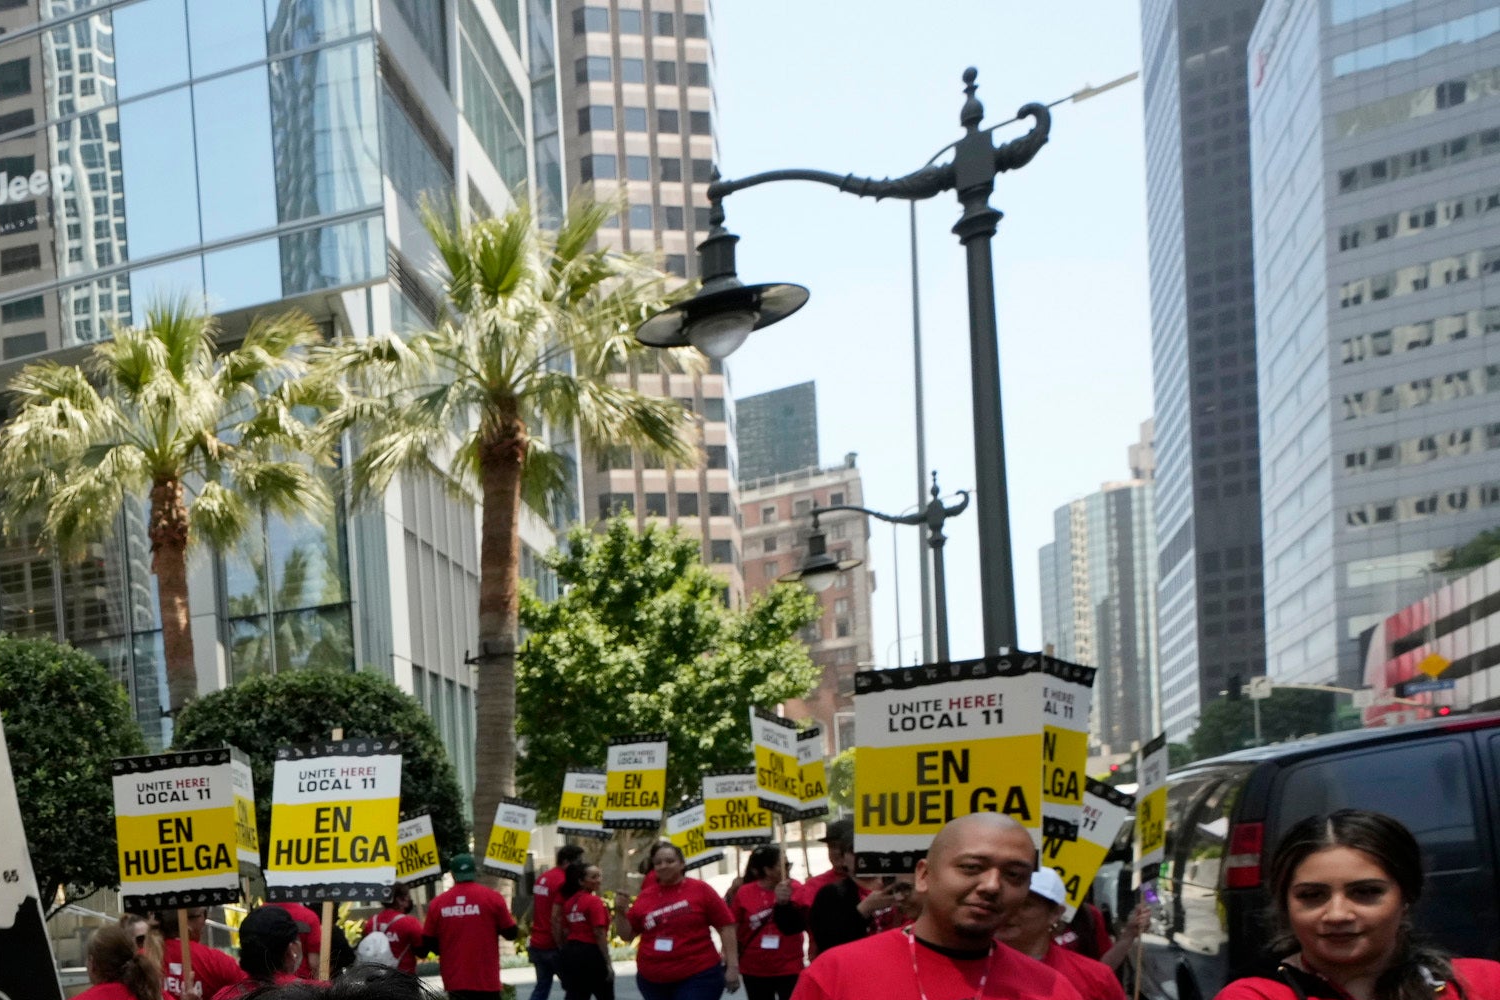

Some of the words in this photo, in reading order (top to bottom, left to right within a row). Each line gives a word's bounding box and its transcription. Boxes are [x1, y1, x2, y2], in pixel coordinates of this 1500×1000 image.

[888, 700, 943, 716] UNITE
[949, 693, 1004, 710] HERE!
[1063, 705, 1074, 719] 11
[888, 711, 968, 733] LOCAL
[981, 708, 1004, 725] 11
[1043, 731, 1057, 762] N
[769, 752, 785, 773] ON
[916, 748, 970, 786] EN
[299, 768, 336, 780] UNITE
[340, 766, 377, 778] HERE!
[624, 773, 642, 790] EN
[758, 767, 798, 796] STRIKE
[1042, 764, 1080, 800] LGA
[136, 780, 173, 793] UNITE
[175, 777, 210, 789] HERE!
[298, 779, 352, 793] LOCAL
[361, 777, 377, 789] 11
[137, 788, 190, 805] LOCAL
[197, 787, 211, 801] 11
[581, 795, 599, 808] EN
[606, 790, 660, 808] HUELGA
[560, 807, 604, 821] HUELG
[725, 799, 748, 814] ON
[861, 786, 1032, 827] HUELGA
[1083, 805, 1103, 818] RE!
[314, 805, 352, 834] EN
[708, 812, 768, 830] STRIKE
[1082, 817, 1098, 832] 11
[157, 816, 193, 845] EN
[503, 830, 519, 847] ON
[274, 835, 391, 866] HUELGA
[400, 841, 419, 858] ON
[488, 842, 526, 864] STRIKE
[123, 843, 232, 877] HUELGA
[396, 851, 437, 875] TRIKE
[441, 904, 480, 918] HUELGA
